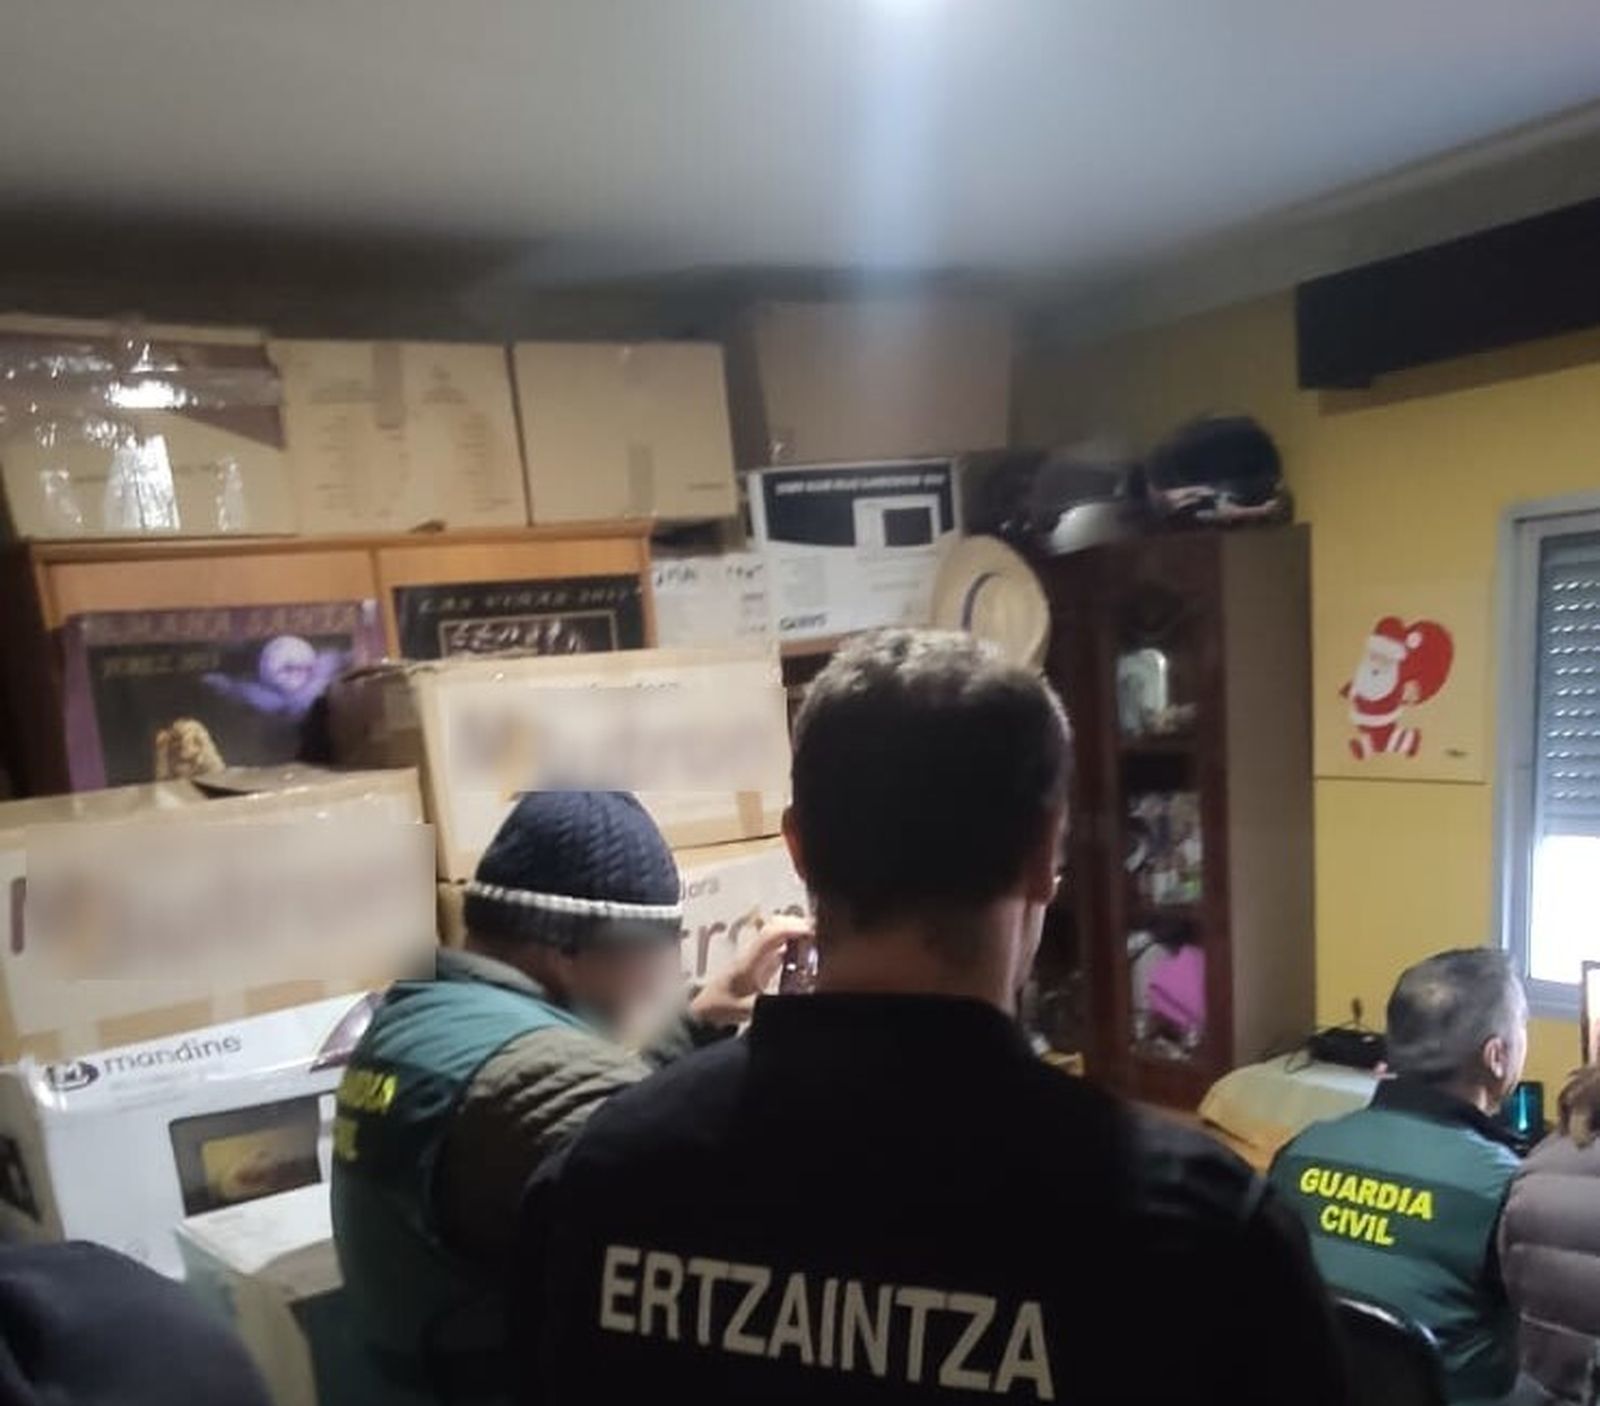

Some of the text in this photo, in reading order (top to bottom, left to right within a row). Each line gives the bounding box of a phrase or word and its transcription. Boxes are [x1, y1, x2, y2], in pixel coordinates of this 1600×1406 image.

[103, 1034, 243, 1074] mandine
[1300, 1167, 1433, 1220] GUARDIA
[1320, 1204, 1395, 1246] CIVIL
[599, 1244, 1056, 1401] ERTZAINTZA
